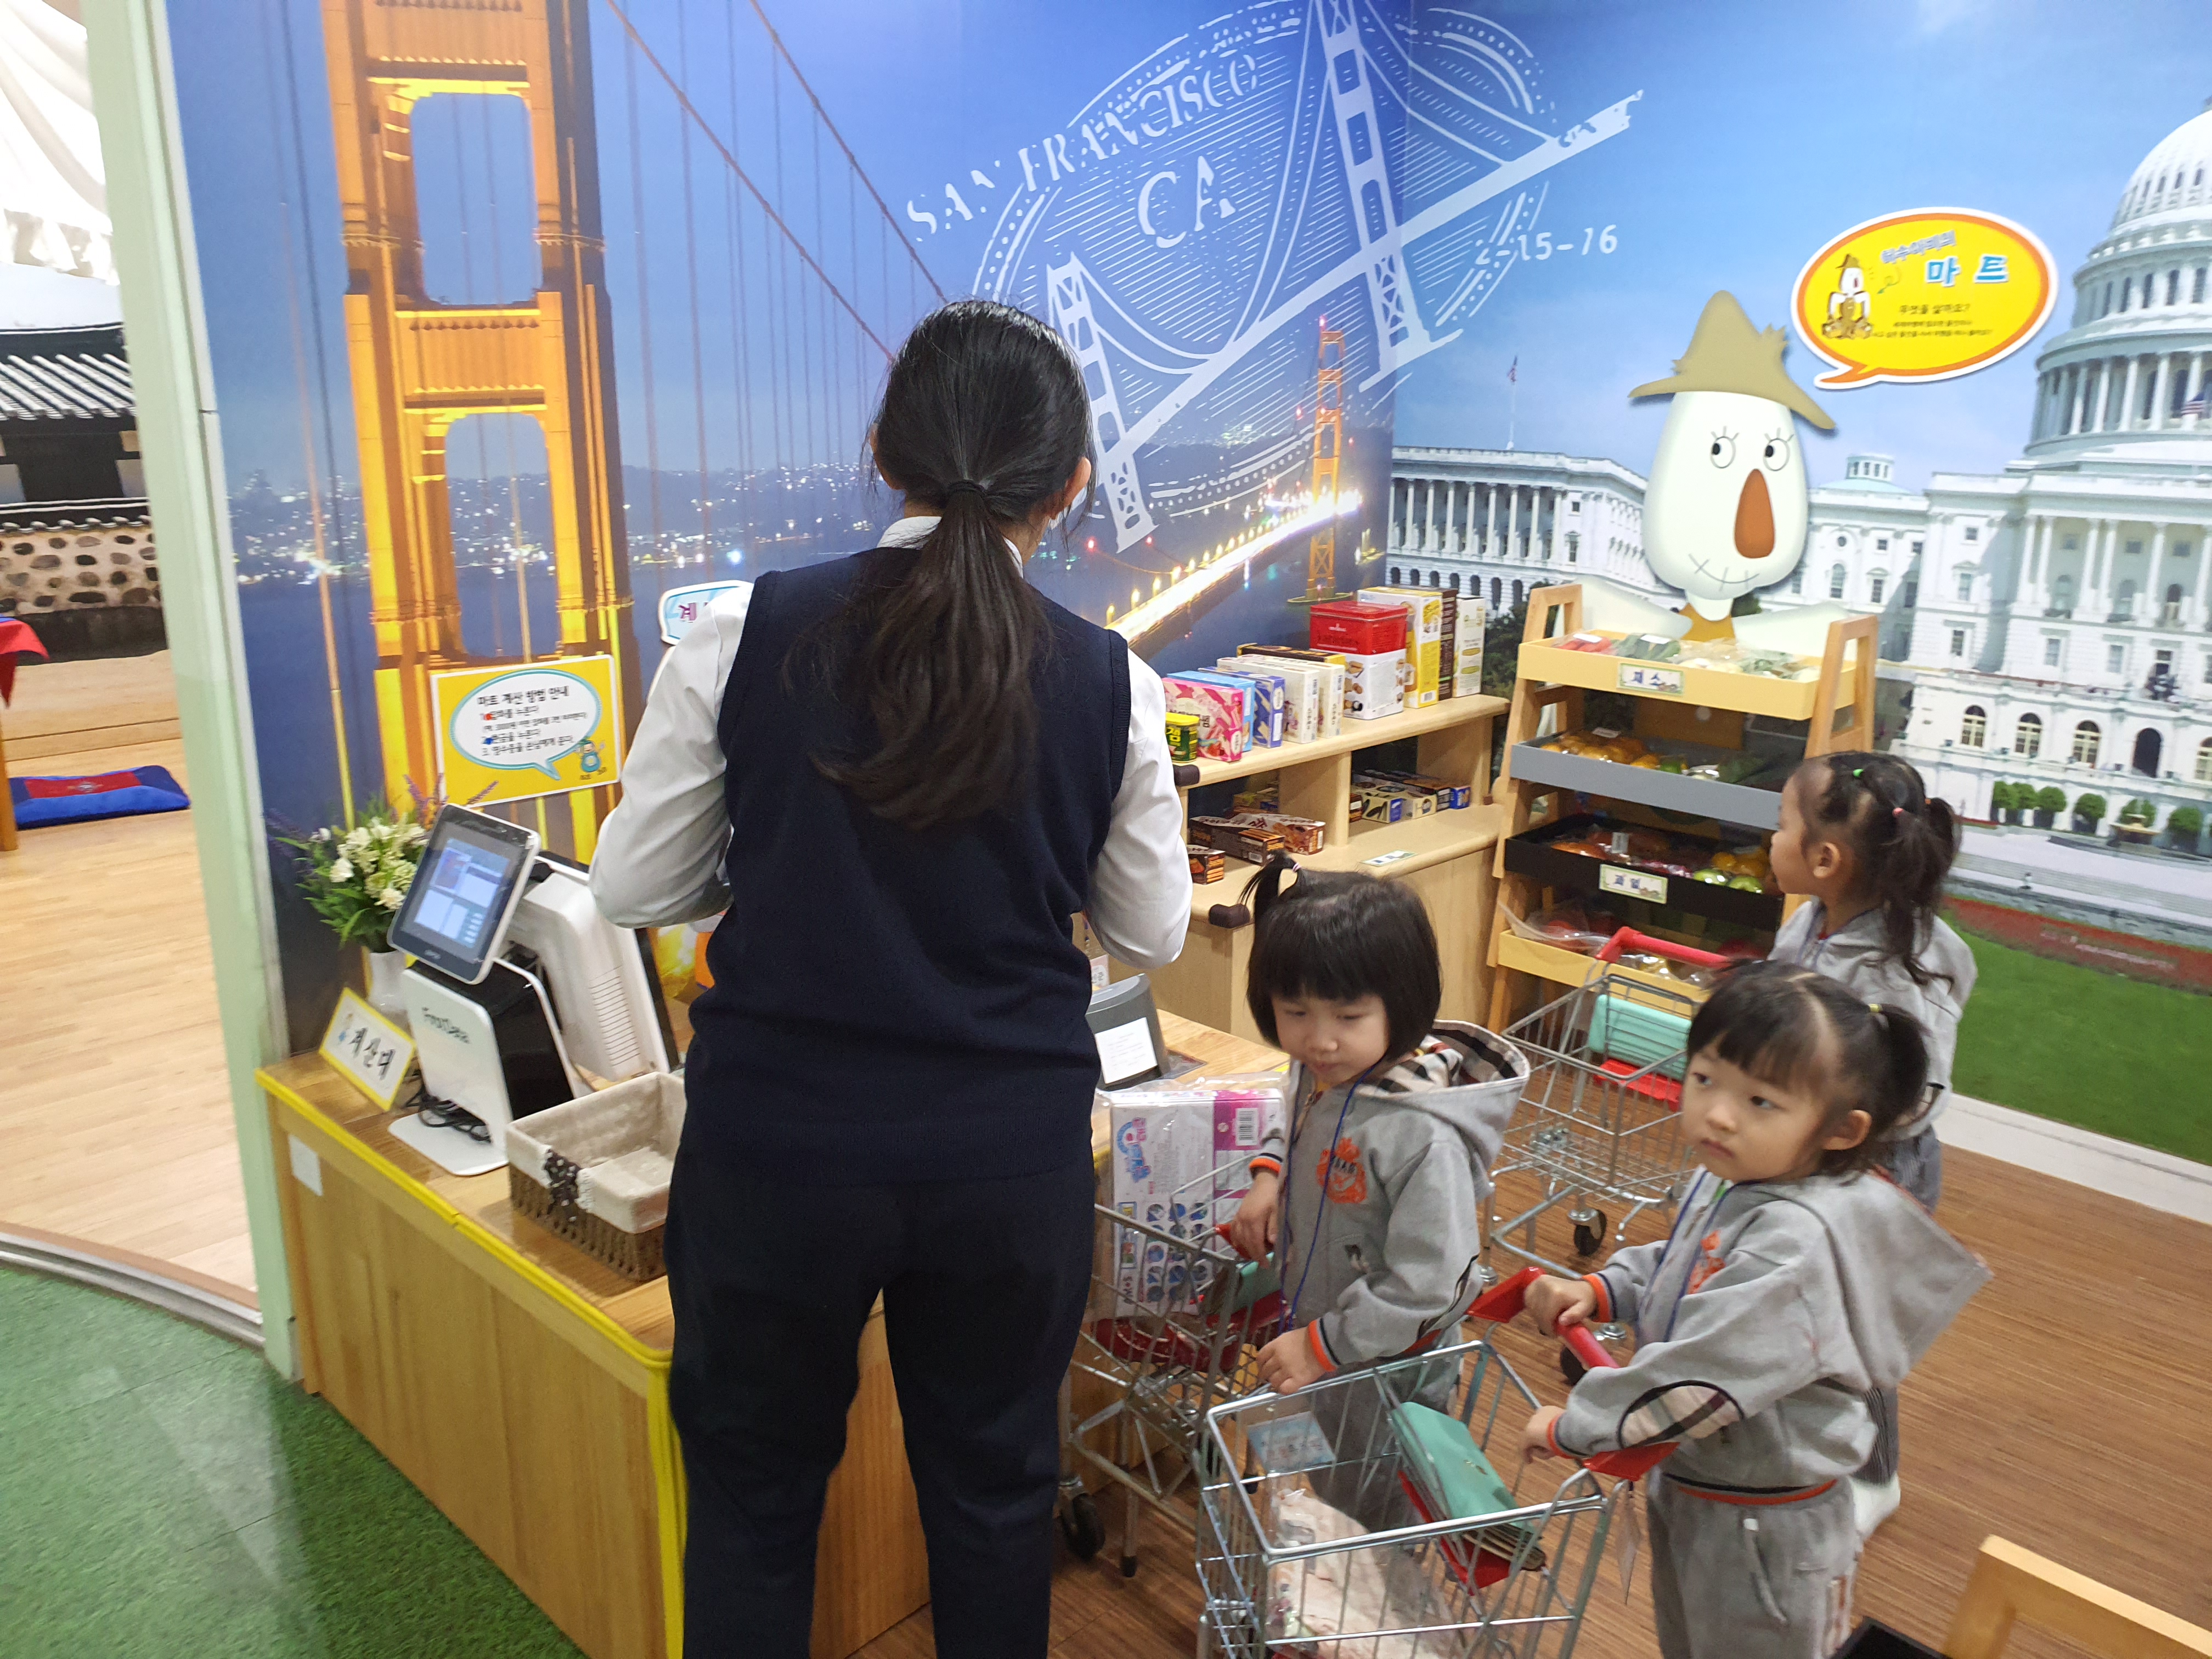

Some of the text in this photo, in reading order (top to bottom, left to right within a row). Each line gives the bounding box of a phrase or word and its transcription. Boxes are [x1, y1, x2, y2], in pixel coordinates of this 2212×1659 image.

[906, 53, 1259, 242] SAN FRANCISCO
[1137, 155, 1237, 249] CA
[477, 695, 500, 706] 마트
[548, 685, 569, 700] 안내
